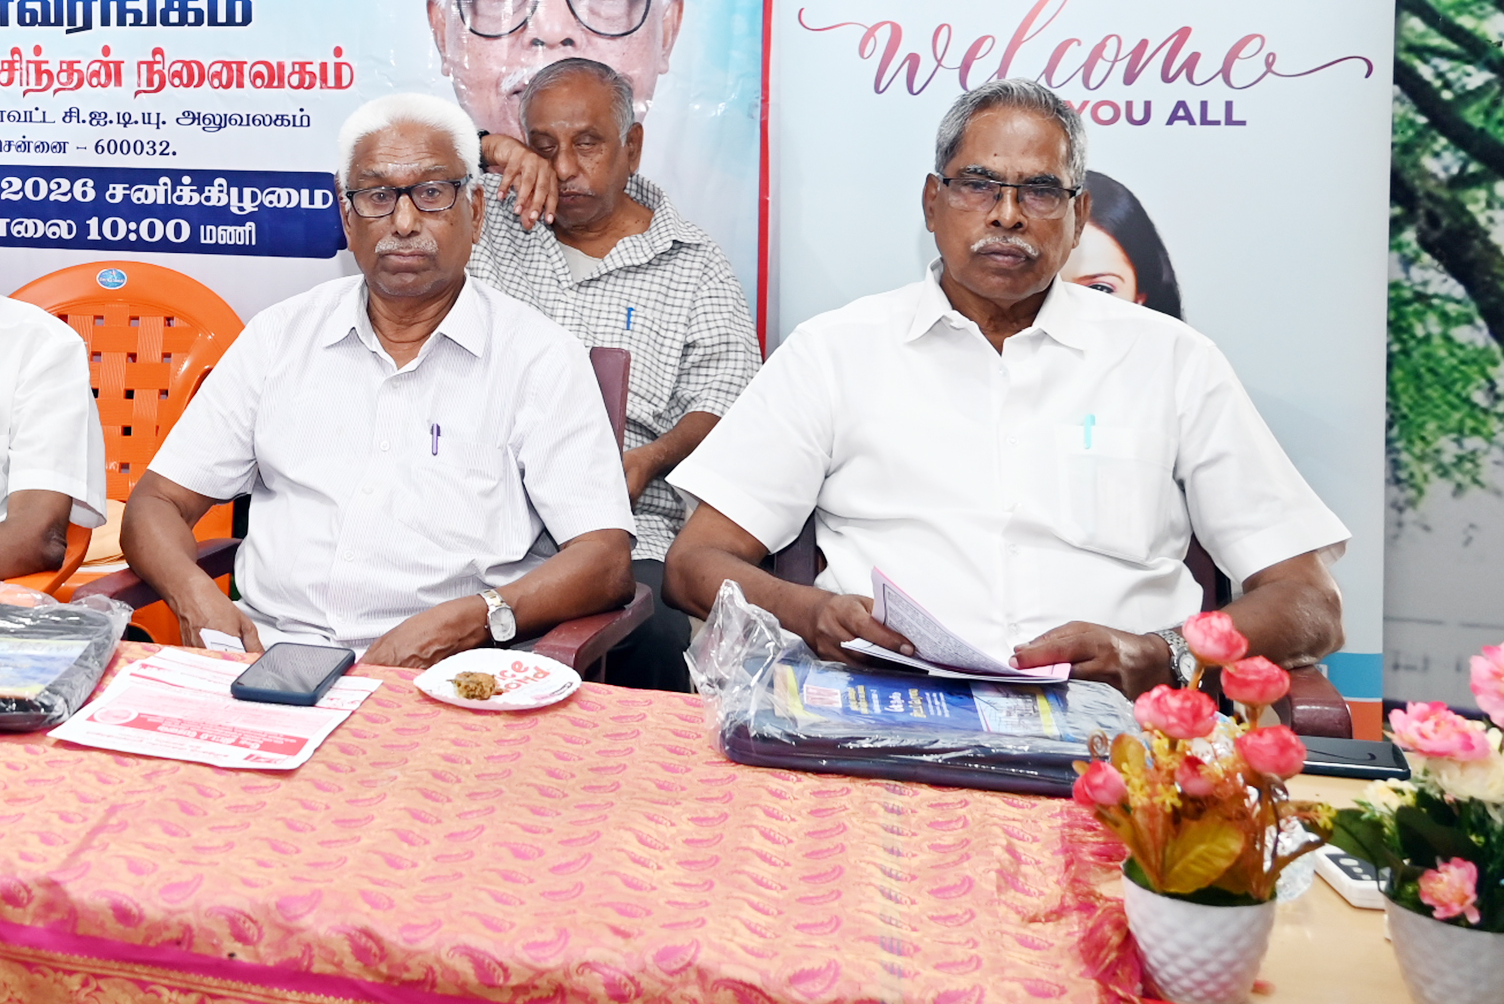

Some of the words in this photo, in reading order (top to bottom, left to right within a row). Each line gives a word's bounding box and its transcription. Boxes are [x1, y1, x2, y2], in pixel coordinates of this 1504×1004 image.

[134, 45, 355, 97] நினைவகம்
[61, 106, 167, 130] சி.ஐ.டி.யு.
[175, 107, 311, 133] அலுவலகம்
[1065, 99, 1152, 127] YOU
[1164, 99, 1247, 127] ALL
[93, 138, 177, 156] 600032.
[105, 174, 334, 216] சனிக்கிழமை
[86, 216, 191, 244] 10:00
[199, 221, 257, 246] மணி
